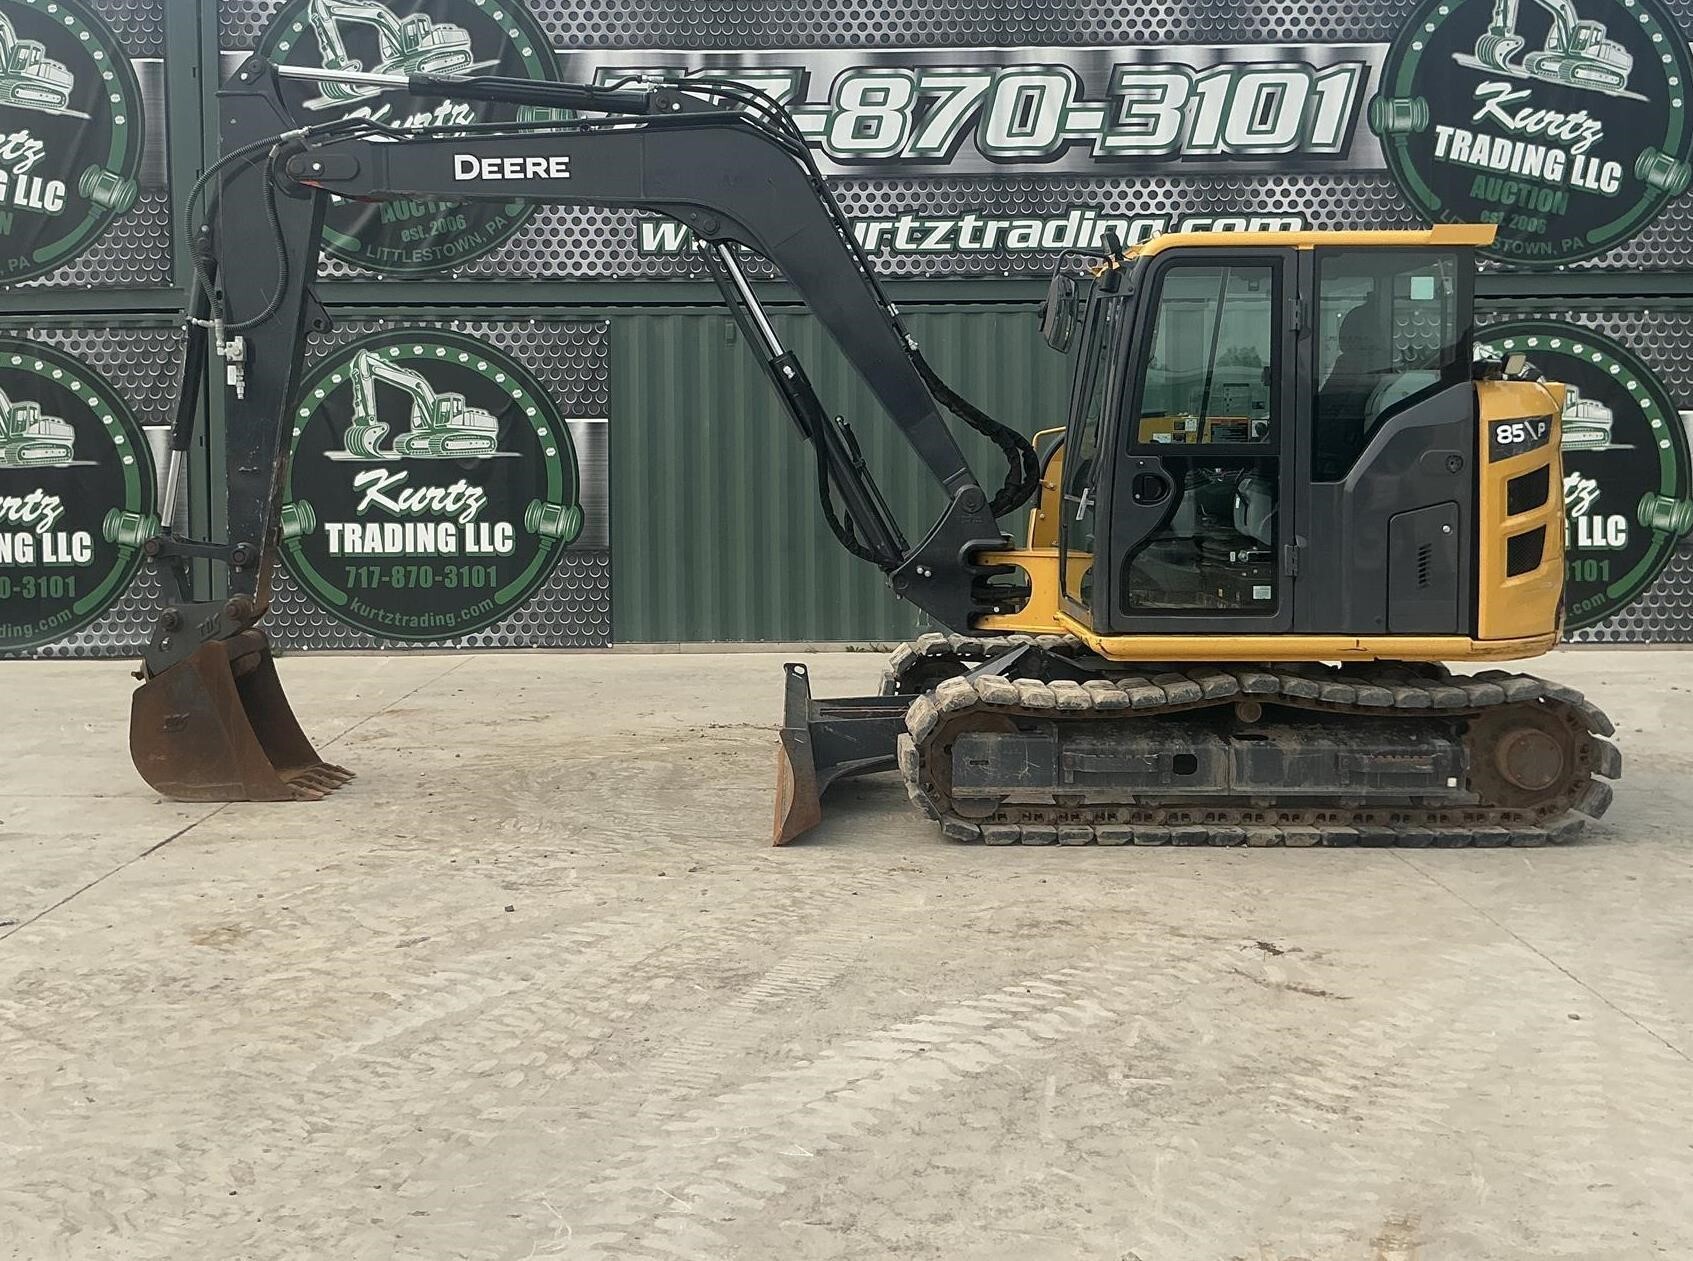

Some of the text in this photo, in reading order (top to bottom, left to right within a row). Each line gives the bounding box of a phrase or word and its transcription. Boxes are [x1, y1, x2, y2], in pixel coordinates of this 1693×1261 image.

[1473, 80, 1604, 155] Kurtz
[454, 154, 570, 180] DEERE
[1434, 125, 1623, 193] TRADING LLC
[13, 174, 66, 212] LLC
[1469, 175, 1569, 216] AUCTION
[366, 216, 509, 263] LITTLESTOWN, PA
[1509, 214, 1548, 235] 2006
[1562, 237, 1584, 252] PA
[8, 256, 31, 272] PA
[1496, 423, 1525, 444] 85
[353, 468, 487, 524] Kurtz
[324, 522, 514, 553] TRADING LLC
[1577, 515, 1627, 547] LLC
[42, 531, 92, 564] LLC
[345, 565, 497, 588] 717-870-3101
[350, 596, 494, 627] kurtztrading.com
